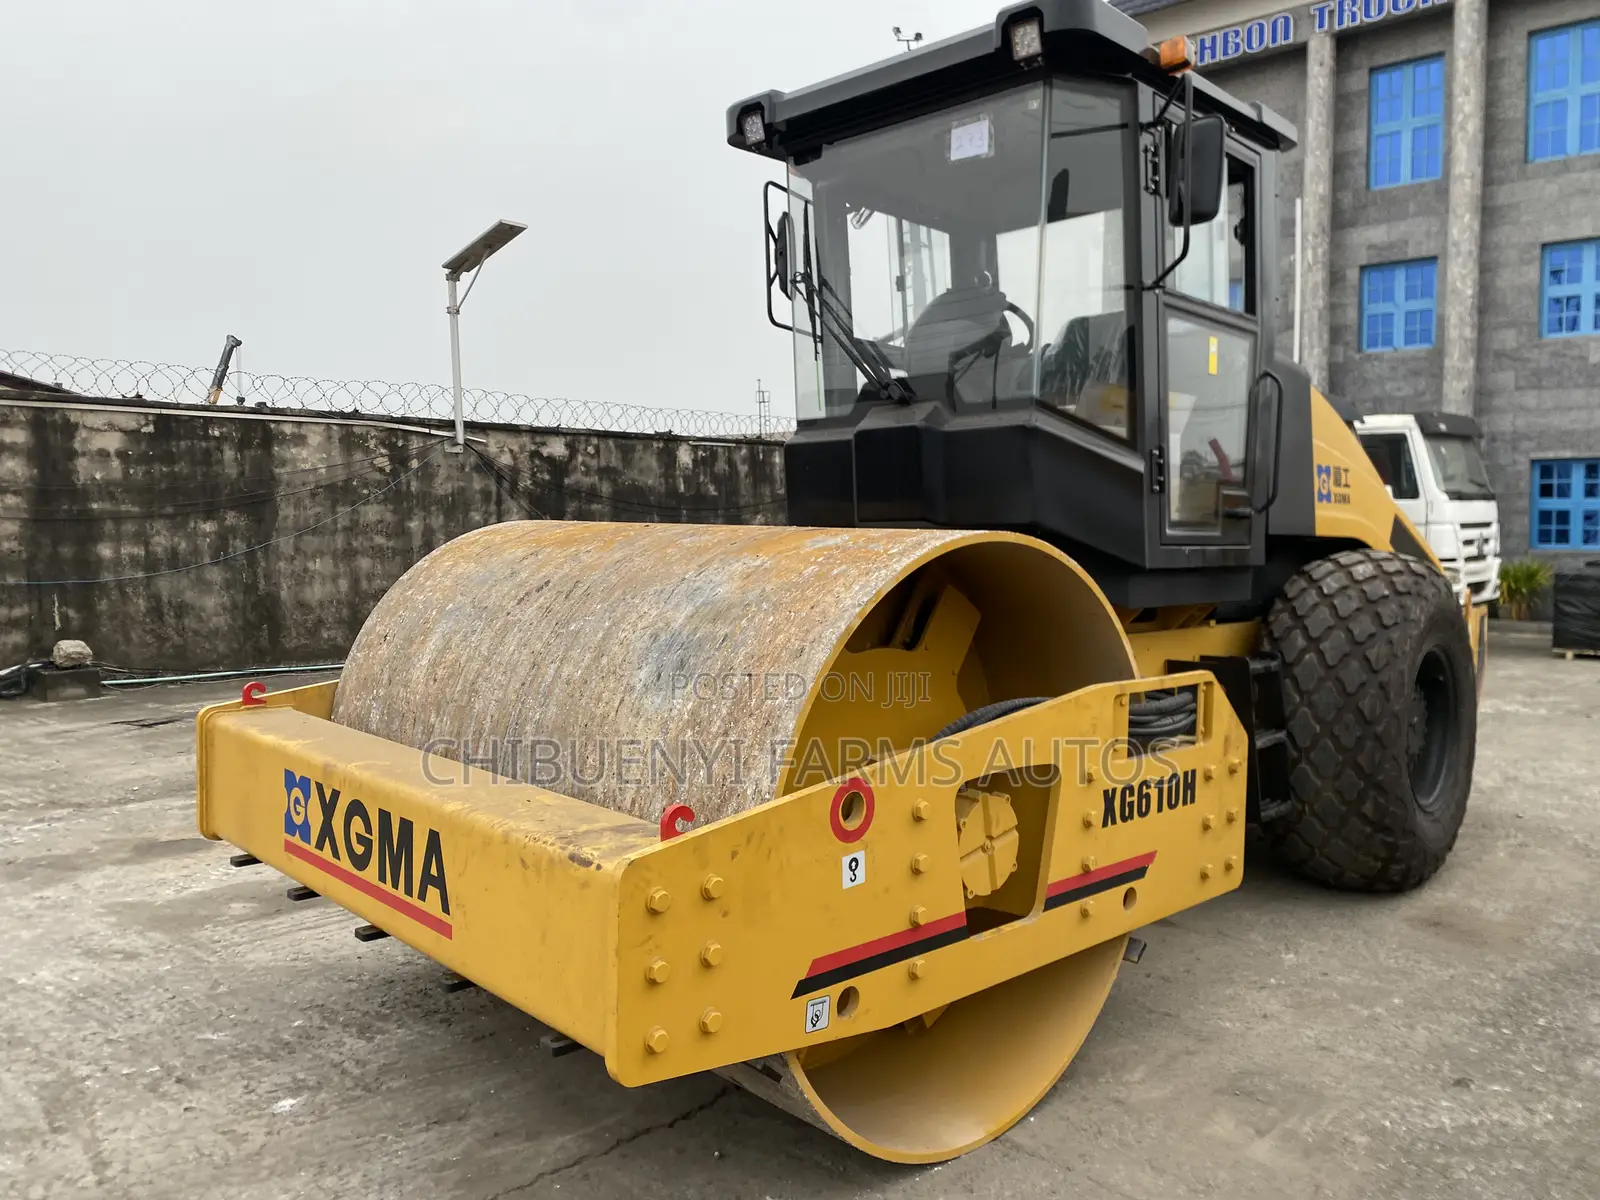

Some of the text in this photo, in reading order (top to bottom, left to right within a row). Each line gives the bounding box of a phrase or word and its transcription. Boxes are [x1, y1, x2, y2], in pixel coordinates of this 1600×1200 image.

[1197, 12, 1293, 66] HBON
[1101, 769, 1197, 828] XG610H
[314, 780, 451, 917] XGMA
